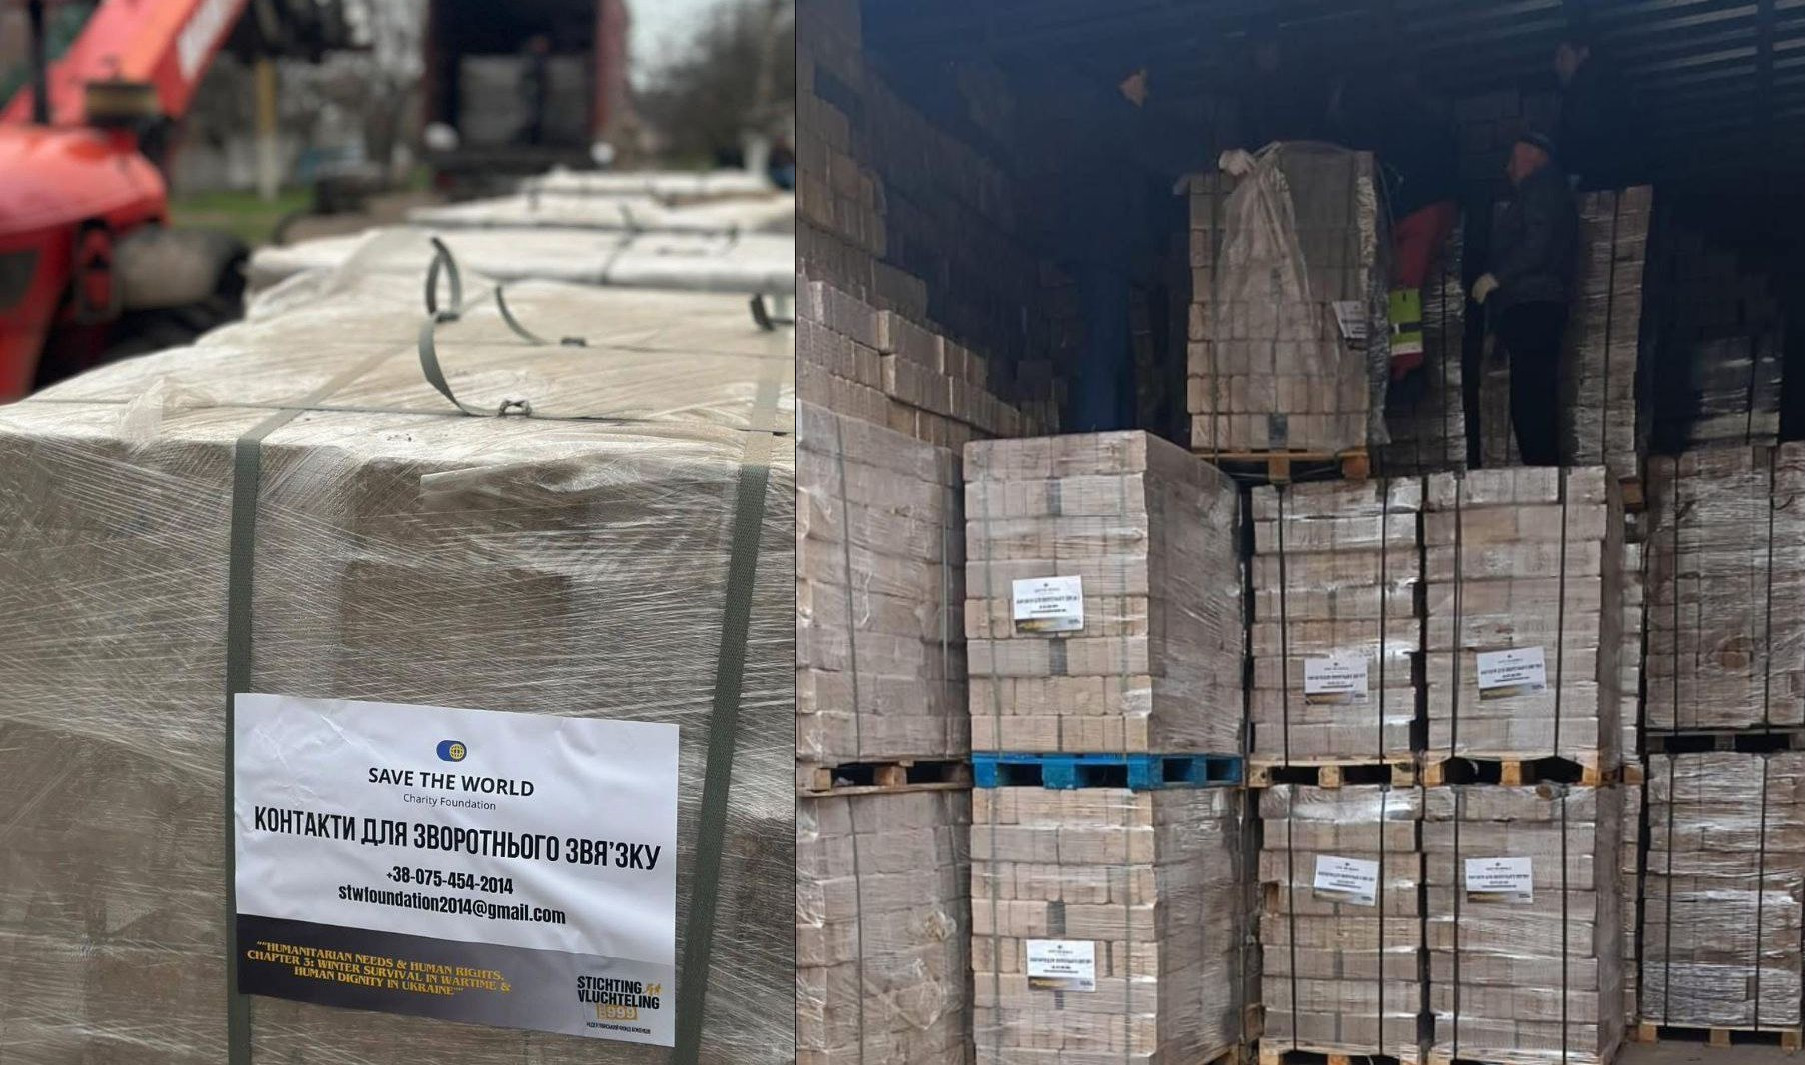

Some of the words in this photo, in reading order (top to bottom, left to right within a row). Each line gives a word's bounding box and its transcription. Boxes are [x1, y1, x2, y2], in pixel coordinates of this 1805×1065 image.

[368, 767, 414, 787] SAVE
[419, 771, 456, 791] THE
[461, 775, 534, 797] WORLD
[403, 793, 438, 808] Charity
[440, 795, 496, 811] Foundation
[254, 805, 356, 842] КОНТАКТИ
[360, 818, 408, 847] ДЛЯ
[413, 823, 560, 862] ЗВОРОТНЬОГО
[386, 865, 514, 895] +38-075-454-2014
[338, 884, 566, 925] stwfoundation2014@gmail.com
[247, 949, 301, 966] CHAPTER
[303, 957, 314, 968] 3:
[317, 958, 360, 974] WINTER
[363, 965, 424, 982] SURVIVAL
[426, 972, 438, 984] IN
[440, 974, 497, 991] WARTIME
[500, 981, 512, 993] &
[294, 965, 335, 981] HUMAN
[337, 971, 383, 988] DIGNITY
[387, 978, 399, 989] IN
[355, 953, 394, 968] NEEDS
[396, 959, 407, 970] &
[410, 961, 452, 975] HUMAN
[577, 975, 642, 995] STICHTING
[577, 989, 660, 1010] VLUCHTELING
